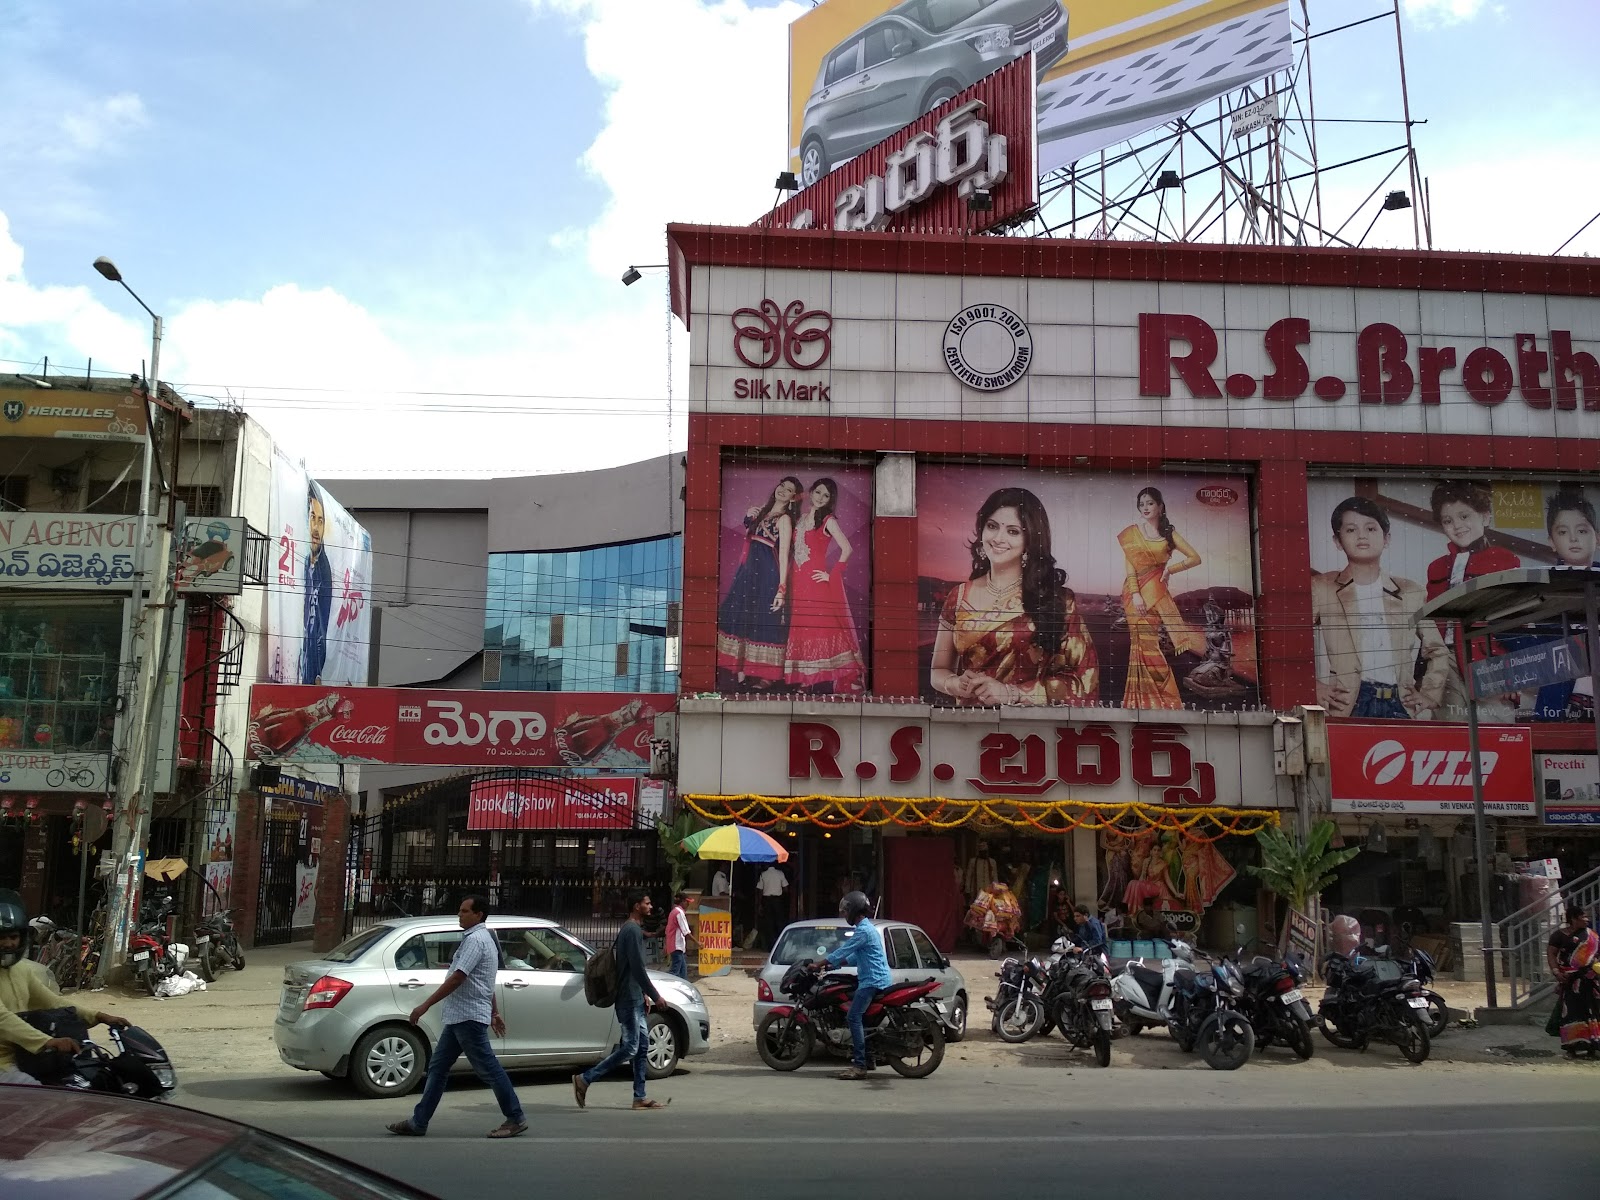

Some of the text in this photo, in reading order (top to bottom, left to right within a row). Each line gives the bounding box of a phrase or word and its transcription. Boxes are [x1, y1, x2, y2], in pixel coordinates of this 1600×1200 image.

[1033, 32, 1055, 50] CELERIO
[949, 316, 968, 336] ISO
[946, 346, 1030, 388] CERTIFIED SHOWROOM
[734, 378, 831, 401] Silk Mark
[27, 405, 115, 419] HERCULES
[1494, 489, 1534, 507] Kids
[1509, 651, 1547, 668] Dilsukhnagar
[400, 709, 419, 718] dts
[1475, 705, 1498, 716] ew
[1543, 706, 1562, 718] for
[423, 700, 547, 746] మెగా
[330, 724, 390, 744] Coca-Cola
[486, 747, 497, 756] 70
[966, 724, 1216, 805] బ్రదర్స్
[1544, 758, 1585, 769] Preethi
[1452, 803, 1505, 811] VENKATHWARA
[699, 920, 730, 934] VALET
[699, 935, 732, 950] PARKING
